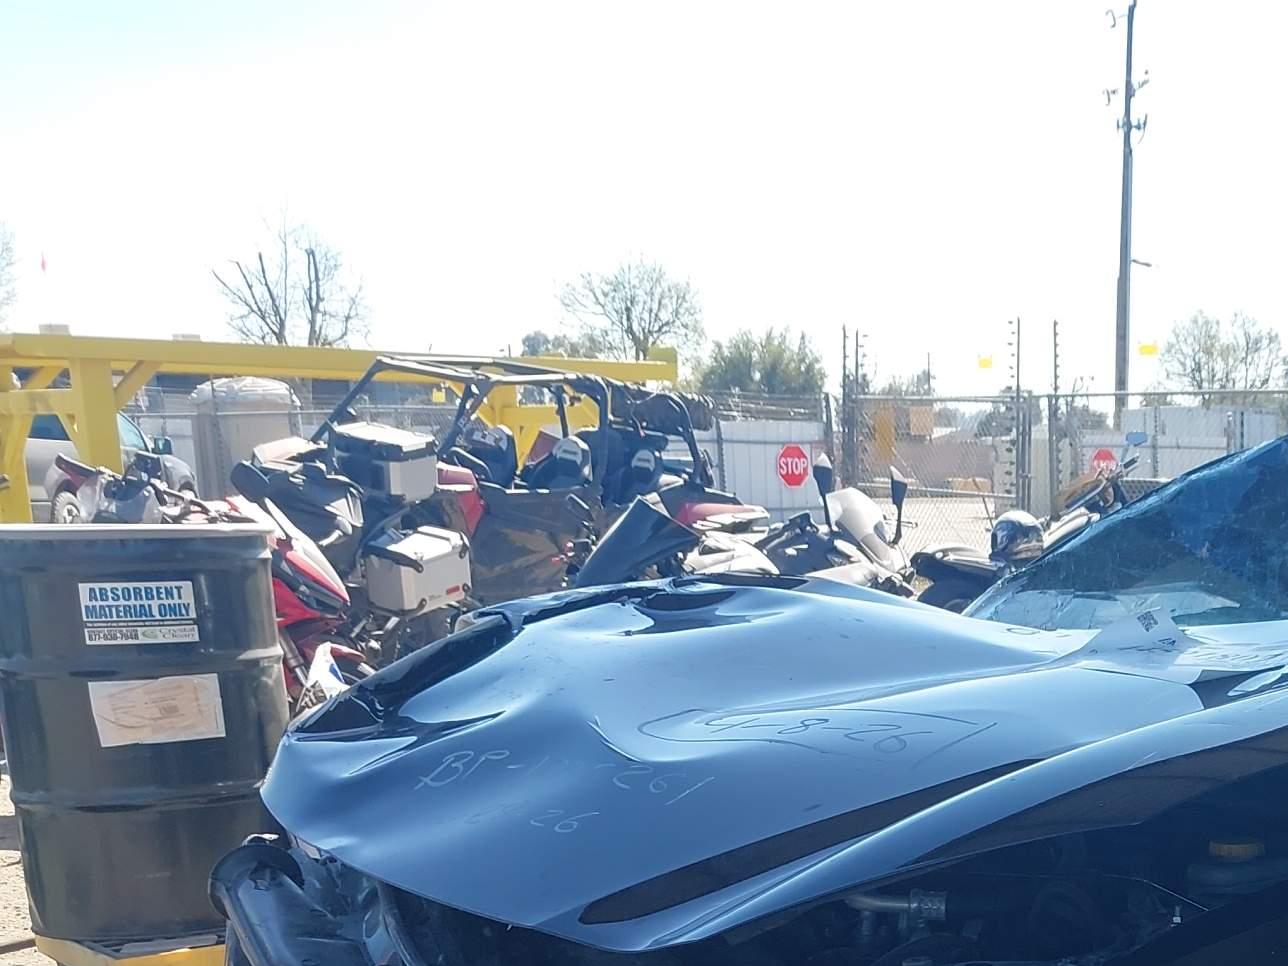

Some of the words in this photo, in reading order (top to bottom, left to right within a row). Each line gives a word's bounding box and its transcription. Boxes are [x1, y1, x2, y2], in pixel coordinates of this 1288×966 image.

[780, 457, 807, 475] STOP
[88, 586, 183, 602] ABSORBENT
[84, 603, 155, 620] MATERIAL
[158, 602, 191, 618] ONLY
